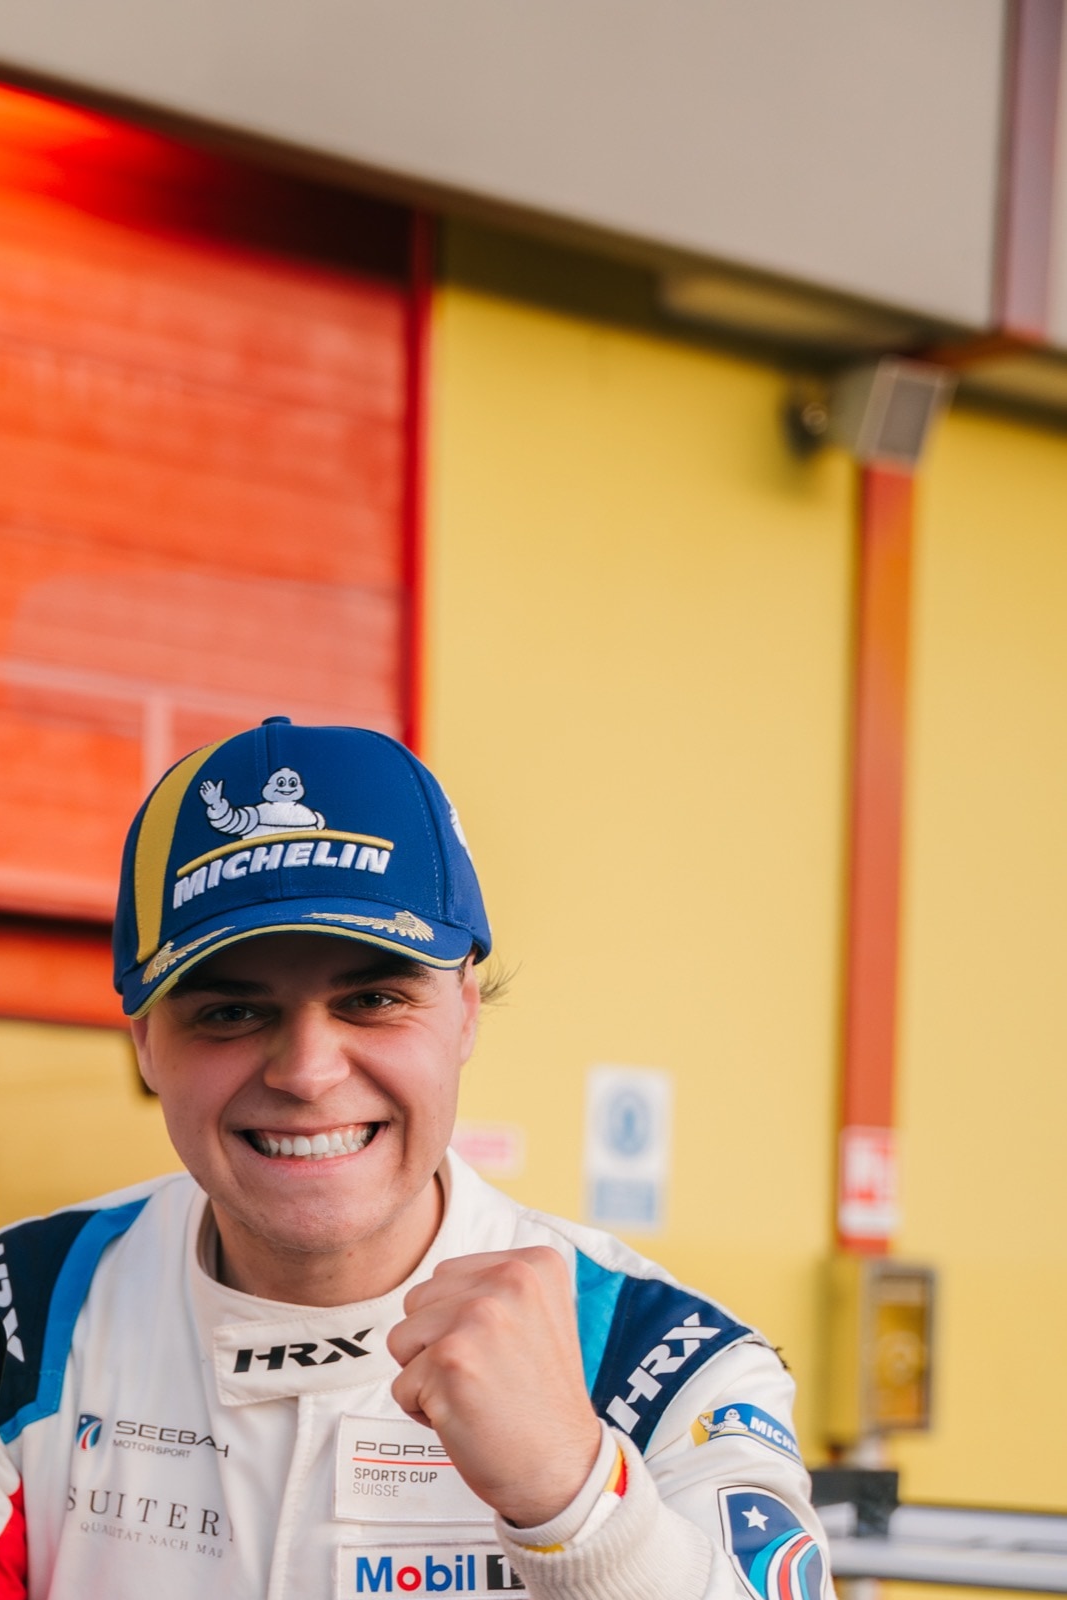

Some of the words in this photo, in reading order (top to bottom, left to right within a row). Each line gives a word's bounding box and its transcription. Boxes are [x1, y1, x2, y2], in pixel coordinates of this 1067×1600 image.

[173, 841, 392, 909] MICHELIN
[234, 1326, 374, 1374] HRX
[606, 1312, 721, 1434] HRX
[112, 1439, 191, 1458] MOTORSPORT
[352, 1481, 400, 1498] SUISSE
[354, 1467, 406, 1483] SPORTS
[409, 1470, 438, 1484] CUP
[356, 1554, 476, 1592] Mobil
